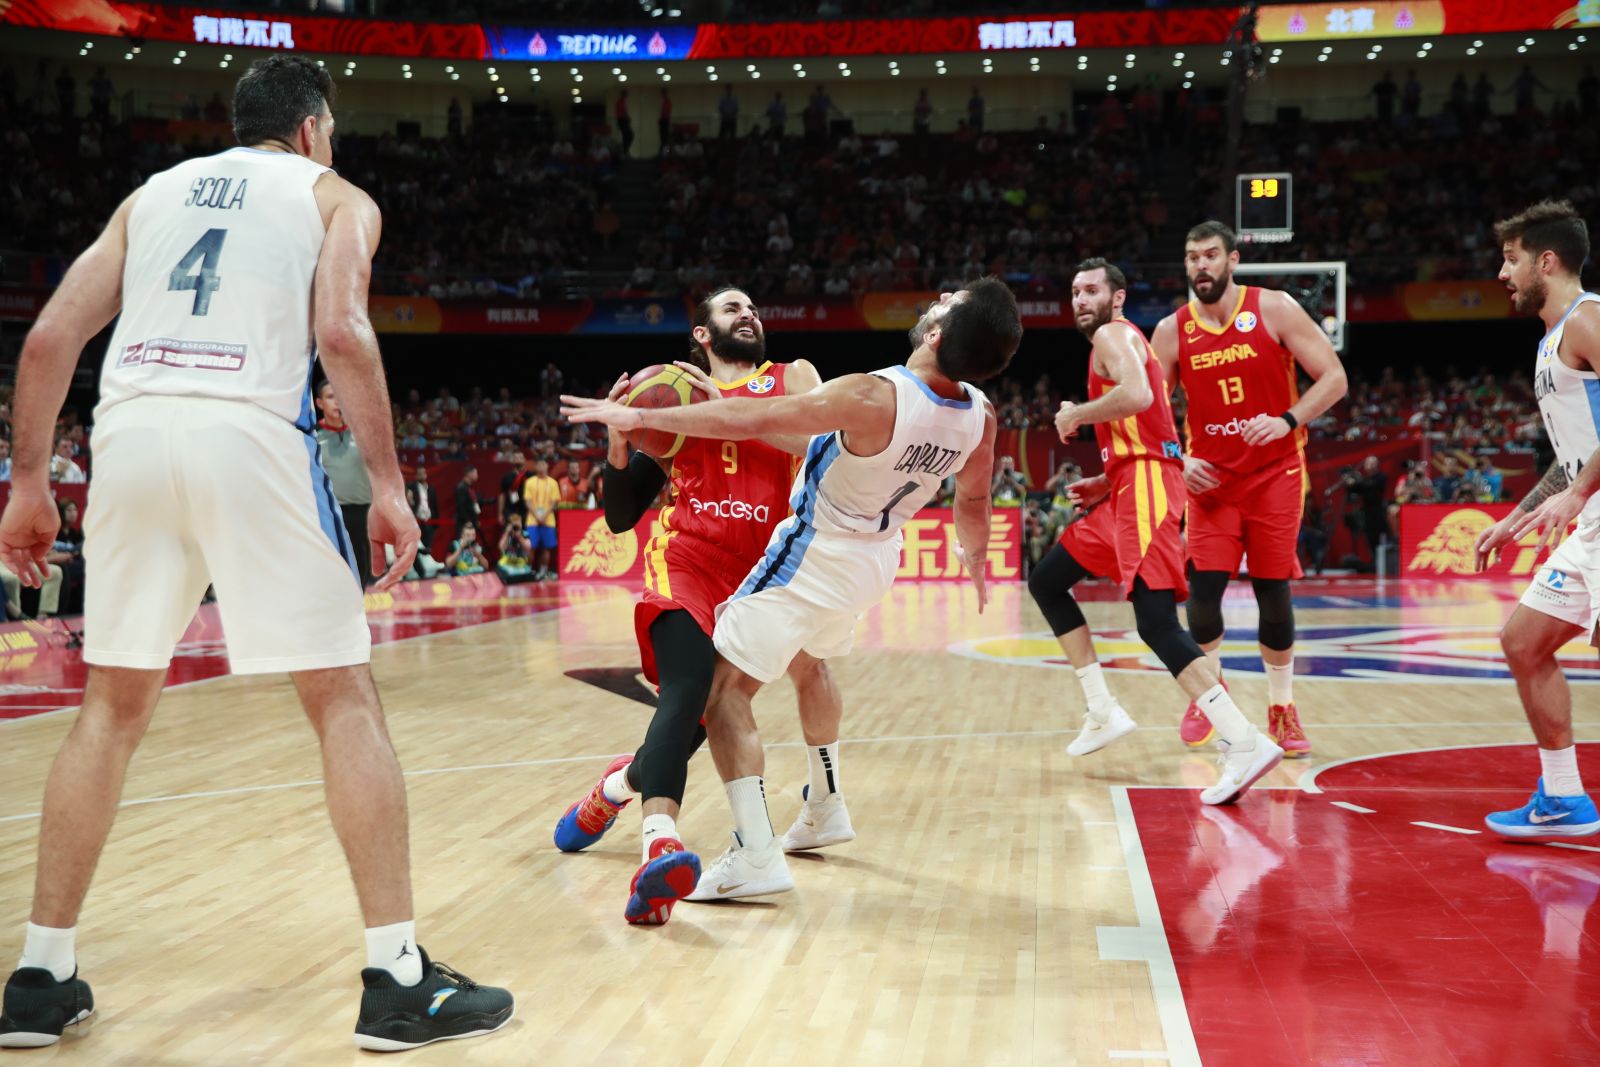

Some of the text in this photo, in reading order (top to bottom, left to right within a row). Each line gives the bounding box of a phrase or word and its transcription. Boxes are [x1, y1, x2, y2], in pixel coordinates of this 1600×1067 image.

[185, 177, 248, 210] SCOLA
[168, 228, 228, 316] 4
[181, 342, 244, 353] ASEGURADOR
[1190, 344, 1258, 371] ESPAÑA
[1217, 376, 1245, 406] 13
[721, 440, 738, 475] 9
[689, 493, 769, 523] endesa
